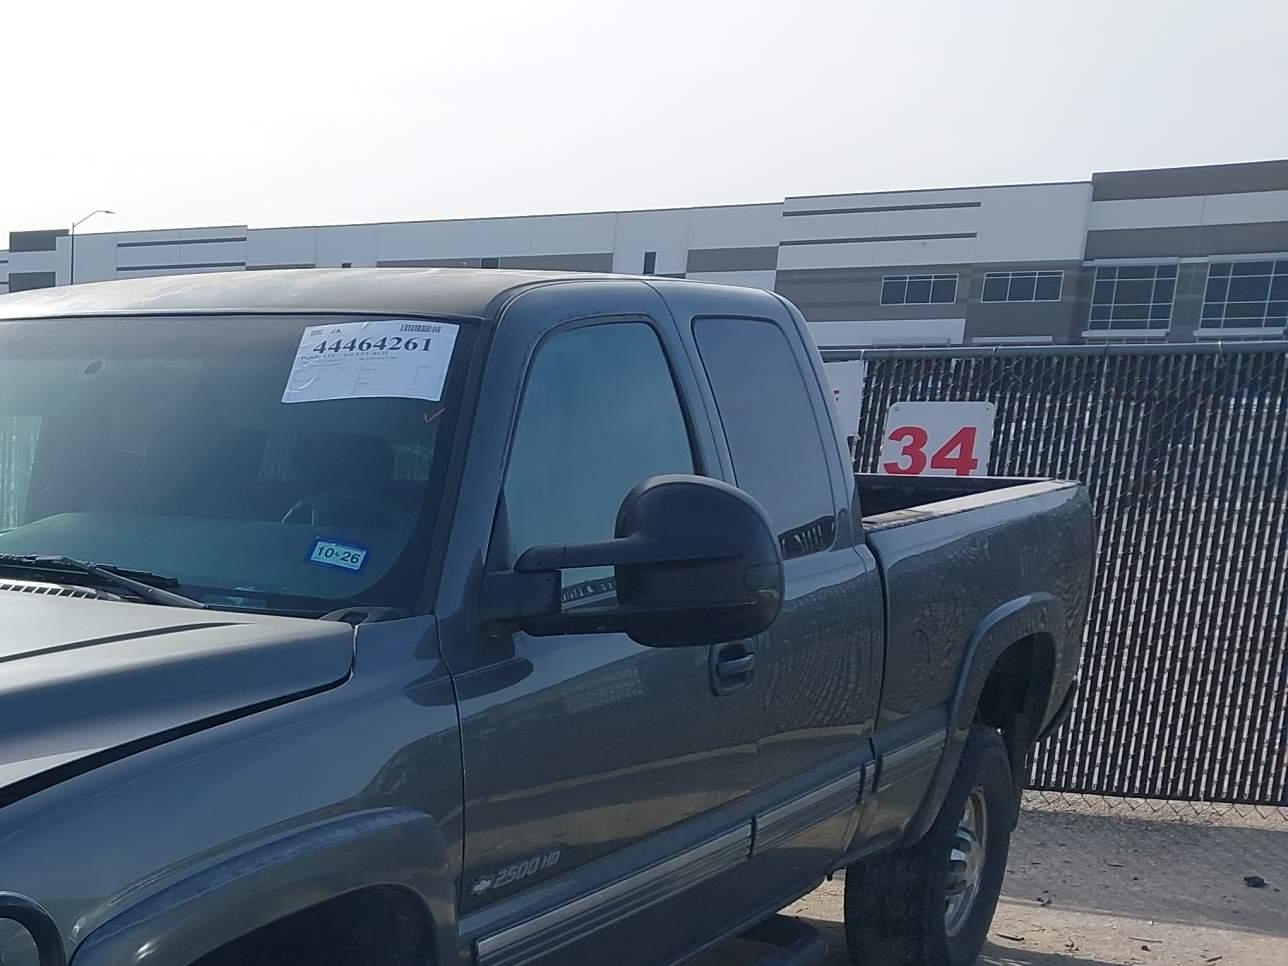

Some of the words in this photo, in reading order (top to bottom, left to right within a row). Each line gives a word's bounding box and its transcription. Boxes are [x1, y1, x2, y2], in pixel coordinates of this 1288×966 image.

[313, 336, 432, 354] 44464261
[884, 427, 978, 476] 34
[493, 857, 541, 889] 2500
